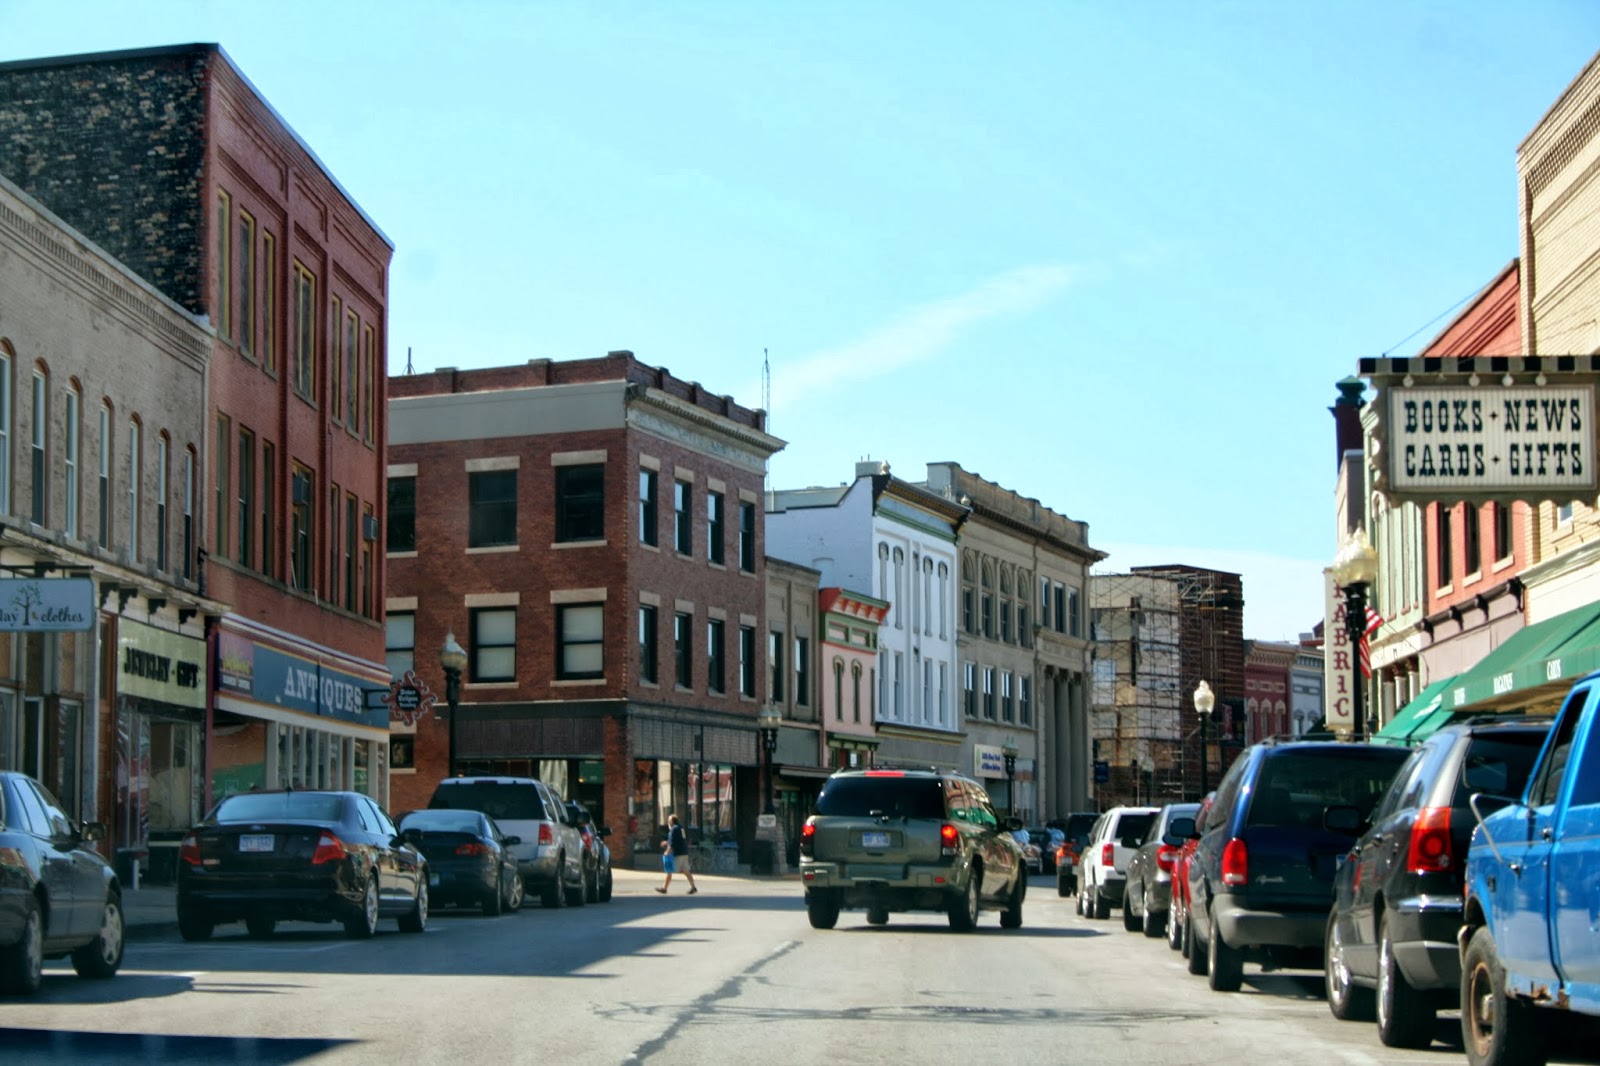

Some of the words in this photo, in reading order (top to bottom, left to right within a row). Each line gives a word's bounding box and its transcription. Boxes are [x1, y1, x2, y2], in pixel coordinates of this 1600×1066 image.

[1404, 399, 1483, 434] BOOKS
[1504, 397, 1581, 432] NEWS
[1405, 443, 1485, 477] CARDS
[1509, 442, 1582, 476] GIFTS
[41, 605, 84, 623] clothes
[284, 666, 363, 714] ANTIQUES
